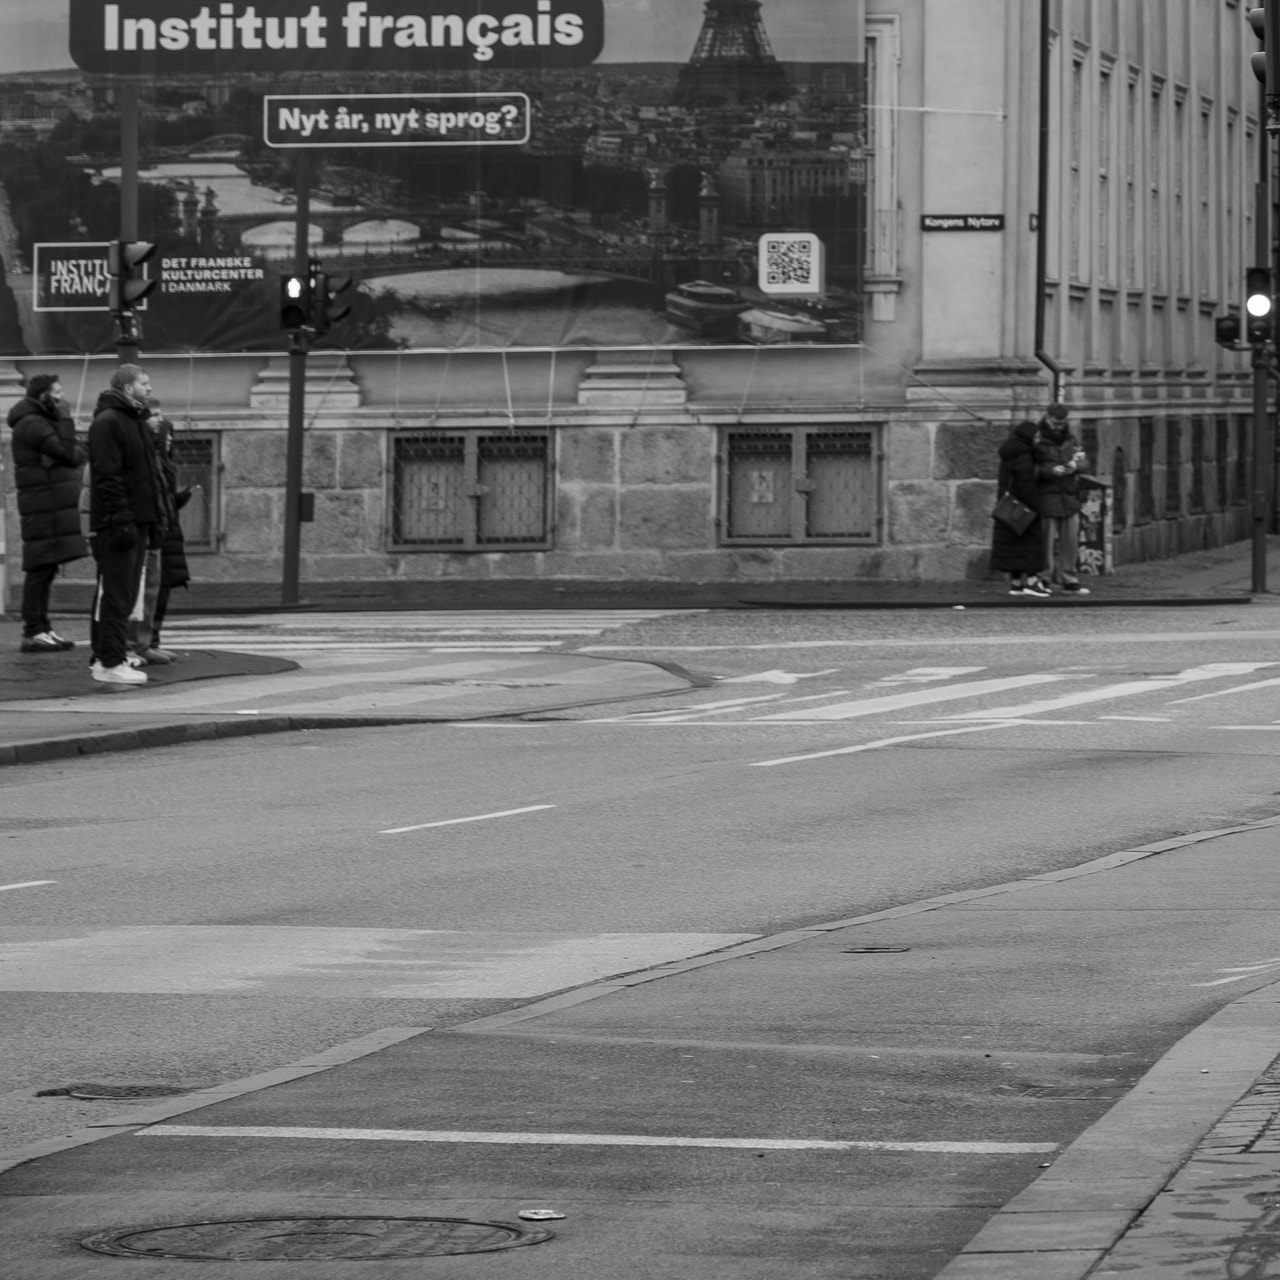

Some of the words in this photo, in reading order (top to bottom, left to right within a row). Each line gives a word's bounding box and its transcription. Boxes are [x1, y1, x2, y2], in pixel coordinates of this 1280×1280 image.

[104, 3, 328, 51] Institut
[342, 0, 584, 61] français
[278, 107, 329, 136] Nyt
[335, 105, 370, 133] år,
[375, 109, 418, 136] nyt
[425, 104, 518, 135] sprog?
[924, 217, 964, 229] Kongens
[967, 216, 1000, 229] Nytorv
[50, 259, 113, 279] INSTIT
[162, 258, 187, 269] DET
[190, 257, 252, 268] FRANSKE
[162, 269, 264, 280] KULTURCENTER
[50, 275, 111, 298] FRANÇ
[169, 281, 232, 292] DANMARK
